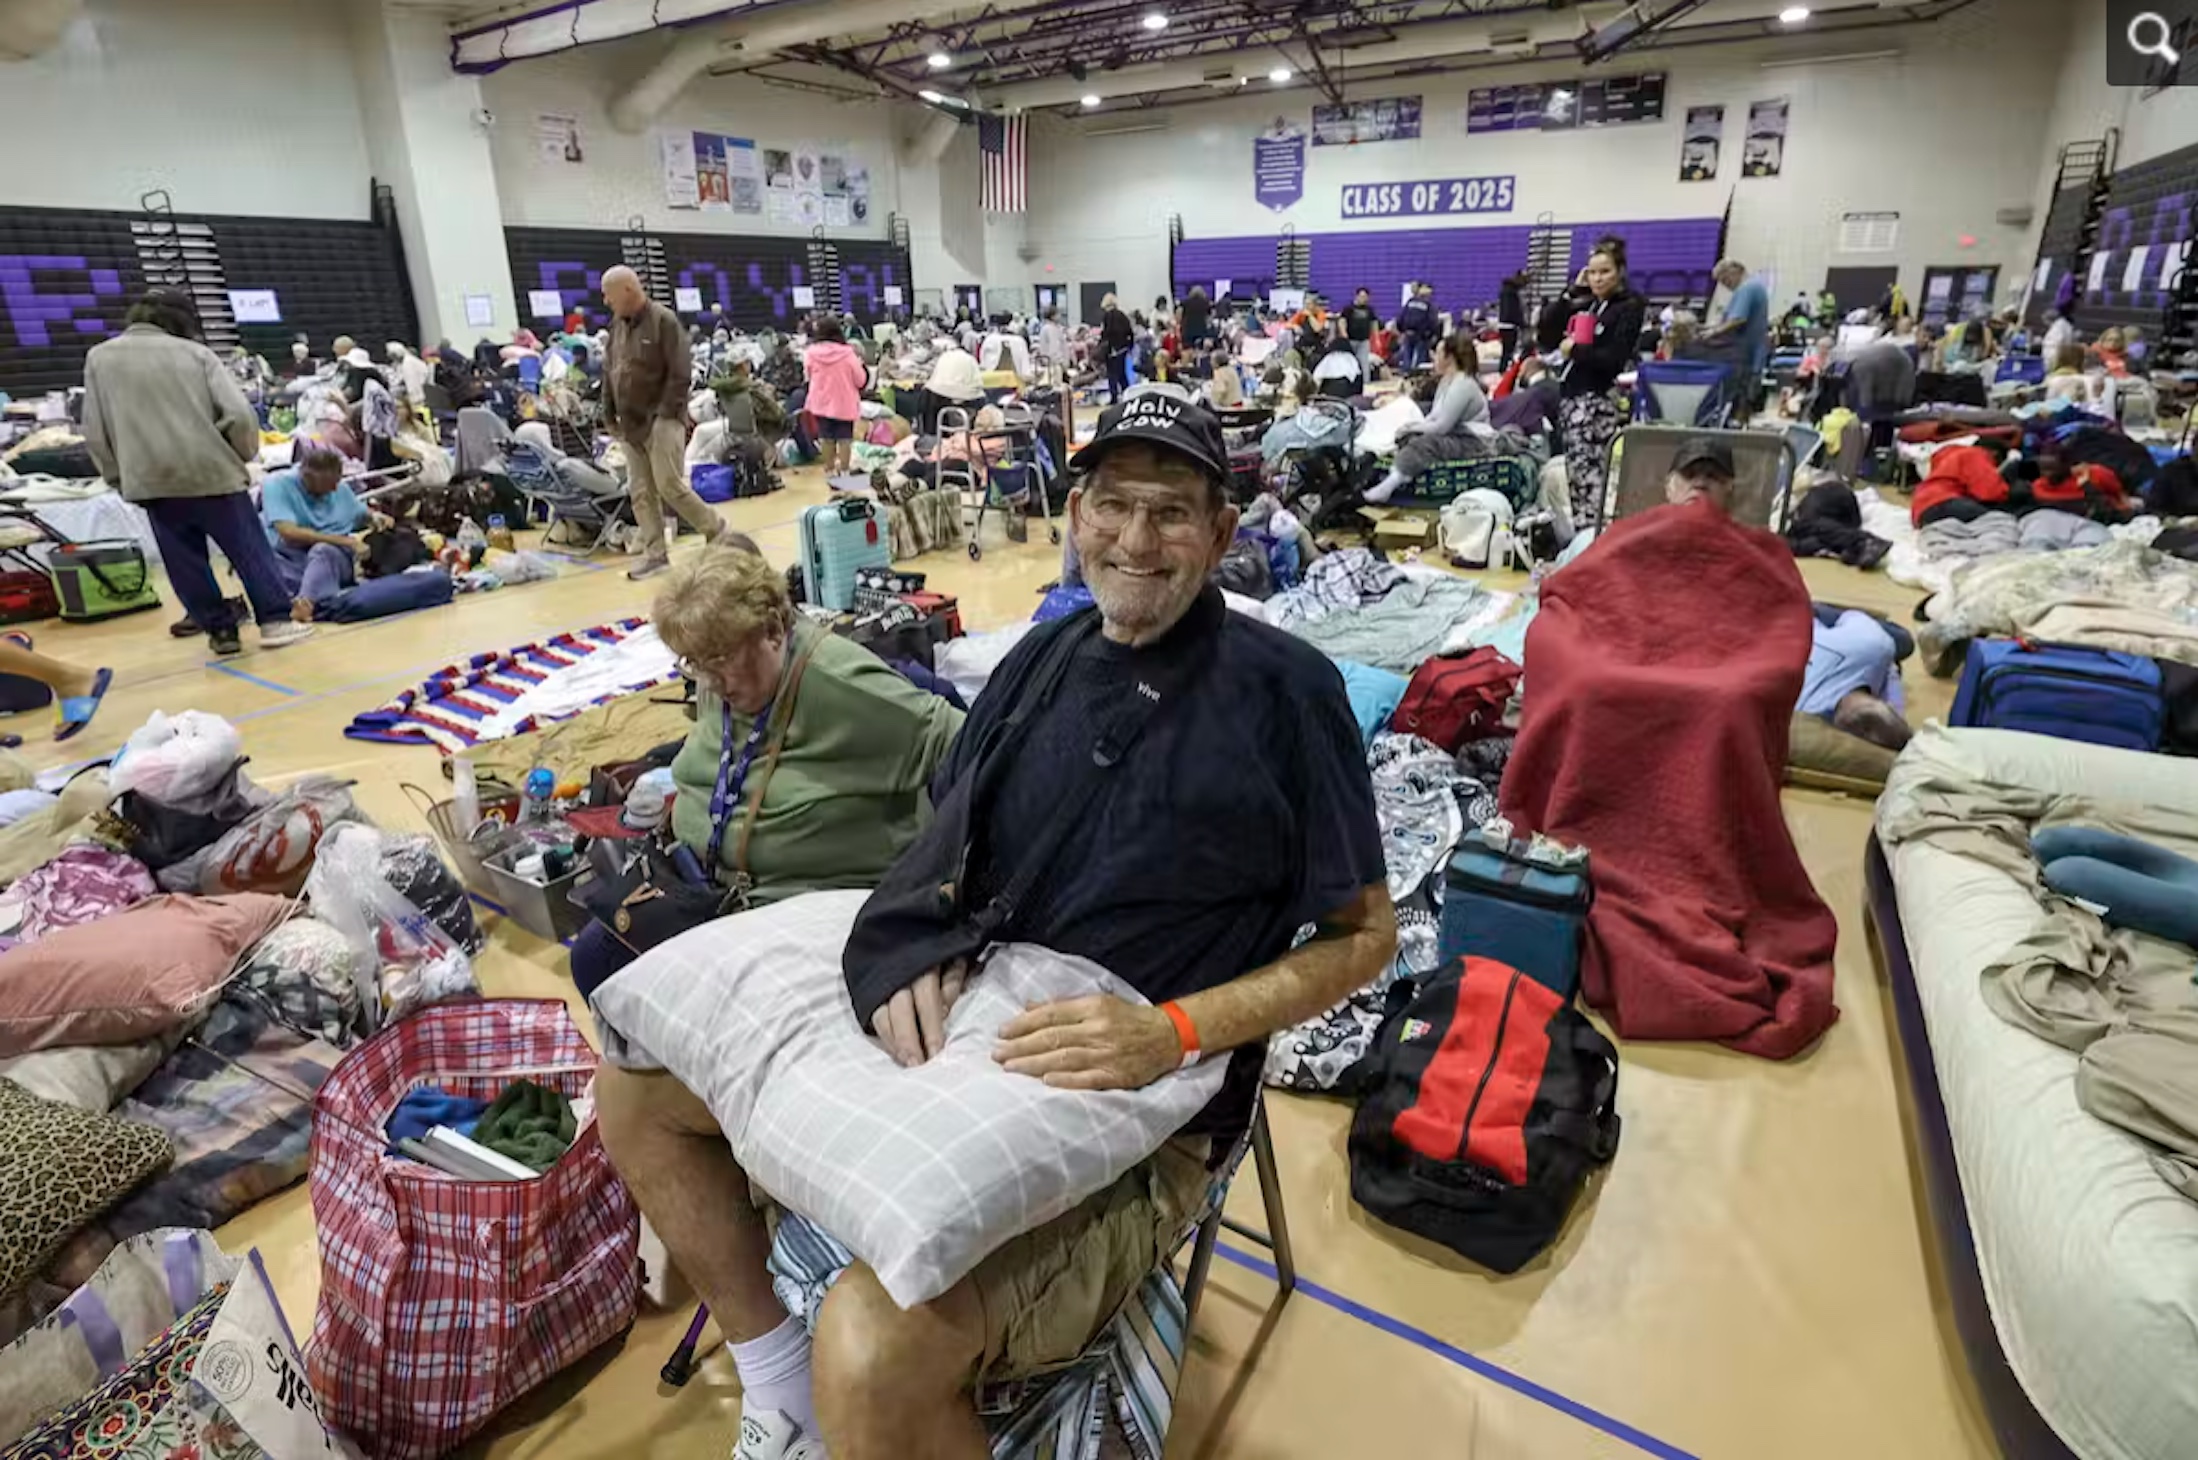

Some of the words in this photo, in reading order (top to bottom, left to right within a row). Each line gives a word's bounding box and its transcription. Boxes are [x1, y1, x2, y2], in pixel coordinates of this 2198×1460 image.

[1343, 185, 1401, 215] CLASS
[1411, 184, 1440, 212] OF
[1449, 177, 1513, 211] 2025
